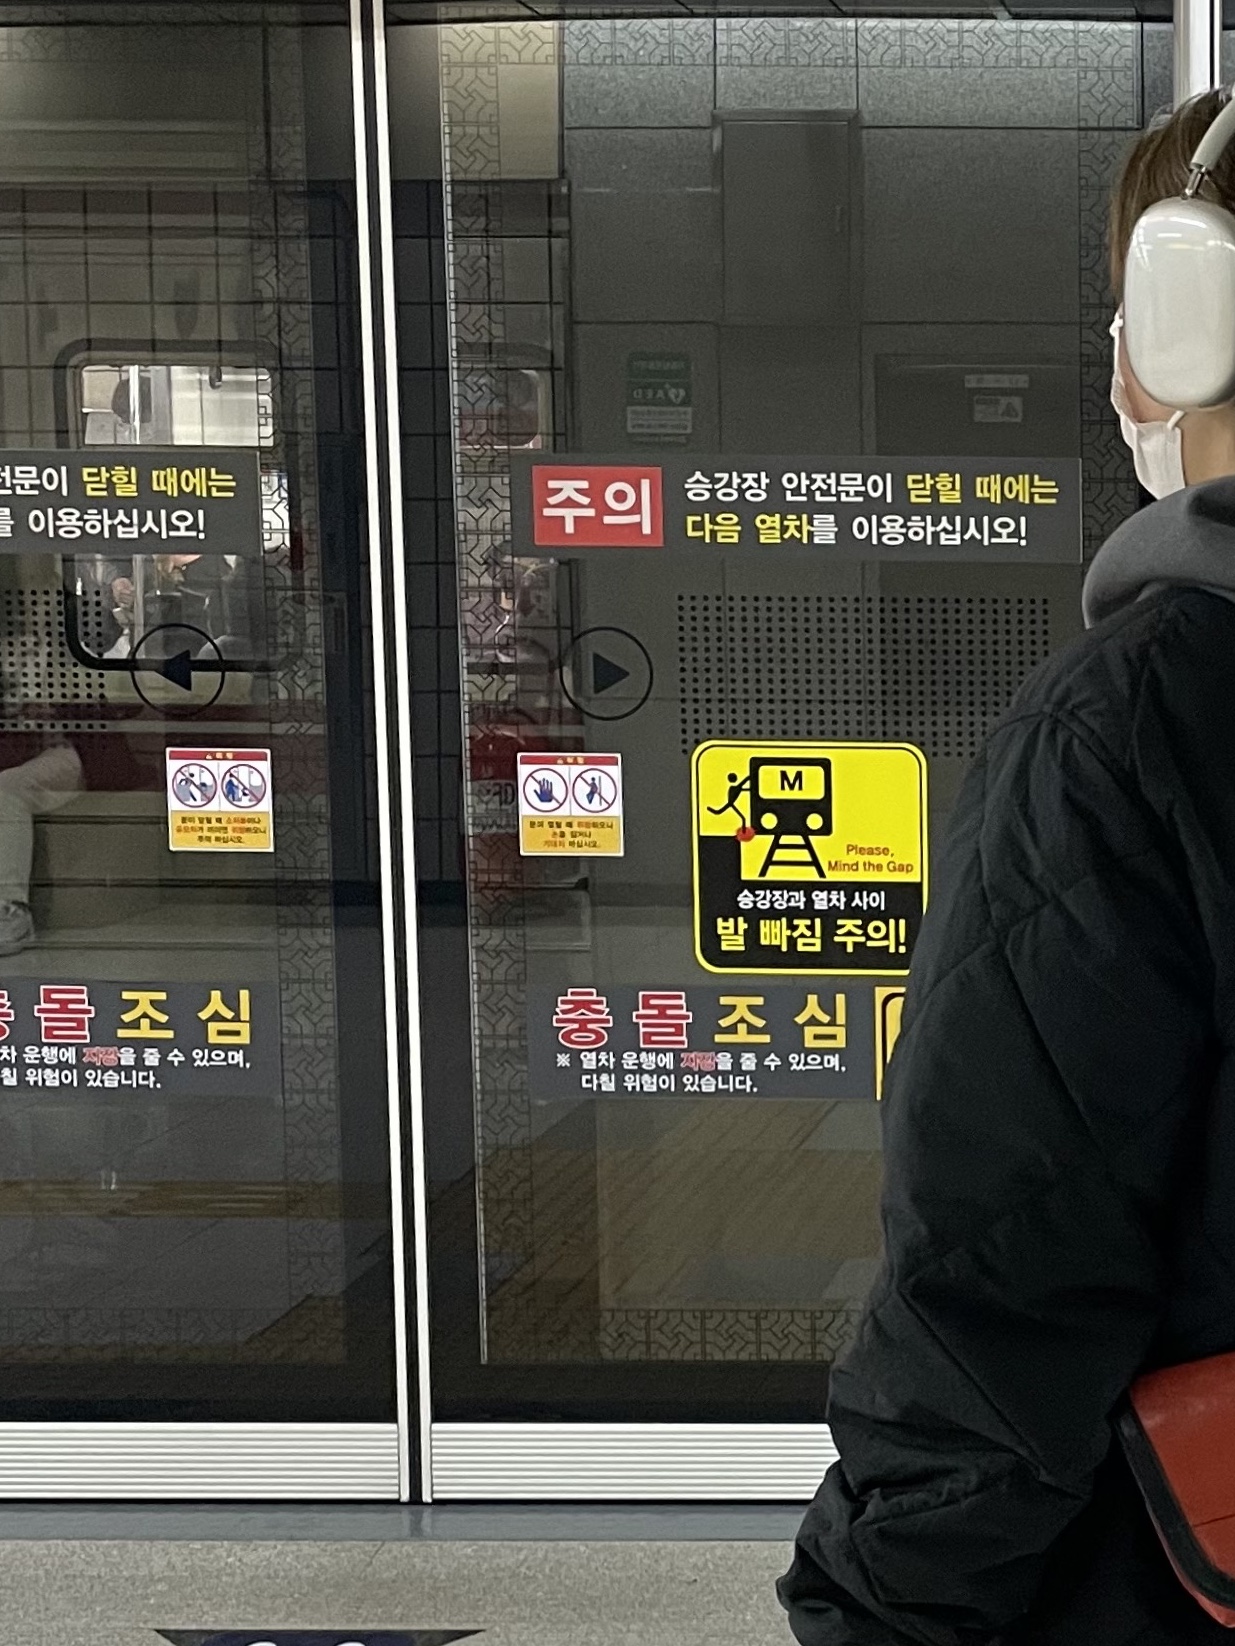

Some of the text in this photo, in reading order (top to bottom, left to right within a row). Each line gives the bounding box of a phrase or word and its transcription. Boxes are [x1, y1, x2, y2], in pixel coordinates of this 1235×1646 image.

[82, 466, 138, 497] 닫힐
[151, 467, 237, 497] 때에는
[685, 471, 1060, 504] 승강장 안전문이 닫힐 때에는
[541, 477, 653, 535] 주의
[28, 507, 206, 539] 이용하십시오!
[686, 513, 1028, 546] 다음 열차를 이용하십시오!
[780, 770, 803, 791] M
[846, 844, 895, 857] Please,
[828, 860, 914, 875] Mind the Gap
[737, 889, 885, 911] 승강장과 열차 사이
[716, 916, 906, 953] 발 빠짐 주의!
[553, 987, 846, 1049] 충돌 조심
[23, 1045, 76, 1064] 운행에
[142, 1047, 161, 1066] 줄
[167, 1048, 185, 1067] 수
[192, 1048, 250, 1069] 있으며,
[580, 1051, 616, 1069] 열차
[621, 1051, 674, 1070] 운행에
[740, 1052, 757, 1071] 줄
[763, 1052, 782, 1071] 수
[788, 1053, 846, 1072] 있으며,
[25, 1067, 78, 1087] 위험이
[85, 1069, 161, 1088] 있습니다.
[581, 1073, 758, 1093] 다칠 위험이 있습니다.
